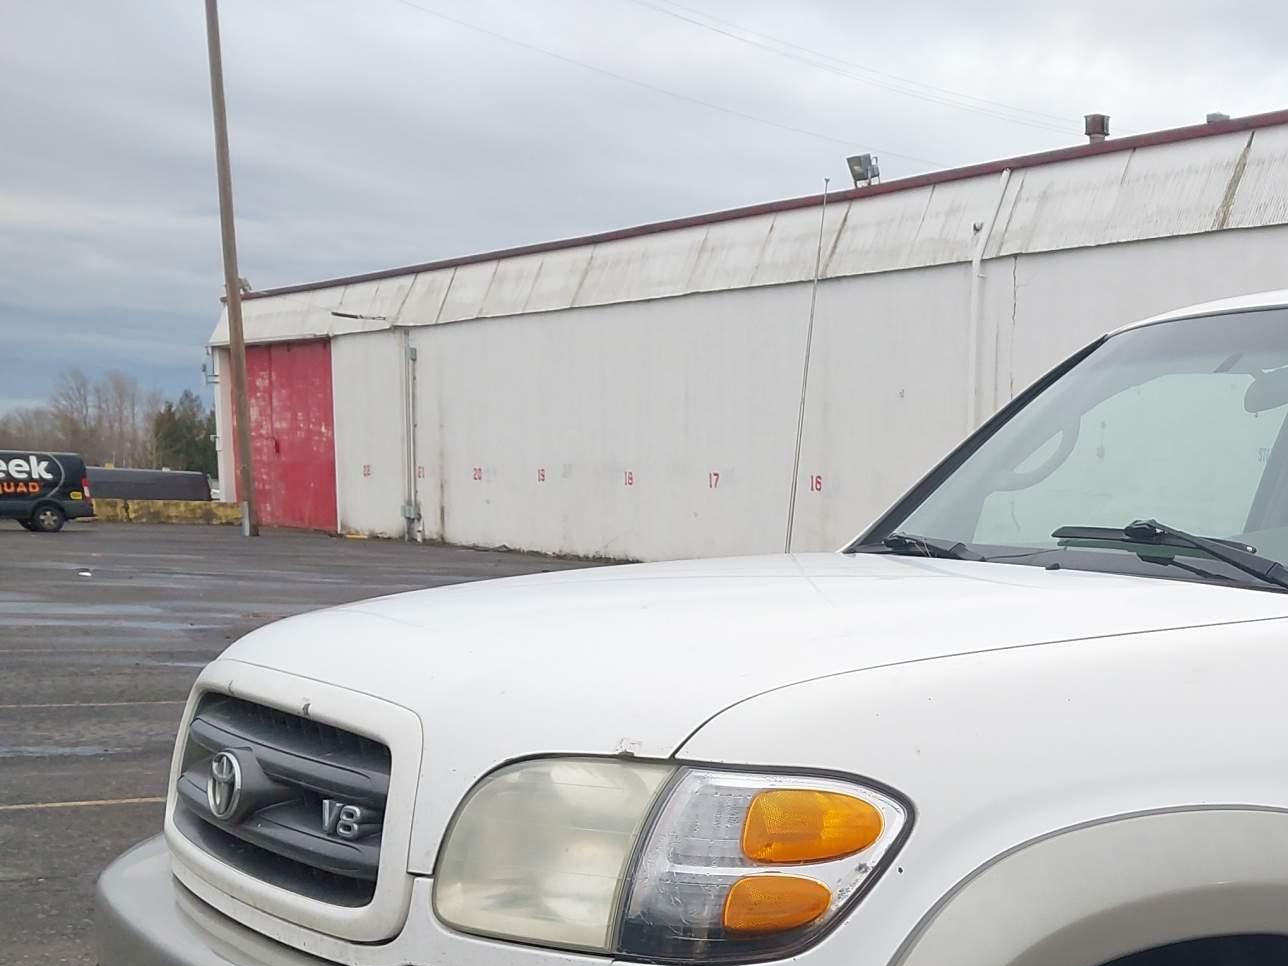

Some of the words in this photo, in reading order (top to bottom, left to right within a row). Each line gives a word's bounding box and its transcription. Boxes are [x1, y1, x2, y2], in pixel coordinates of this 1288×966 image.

[473, 467, 482, 481] 20
[624, 471, 633, 486] 18
[709, 472, 720, 489] 17
[810, 475, 823, 492] 16
[321, 799, 361, 838] V8
